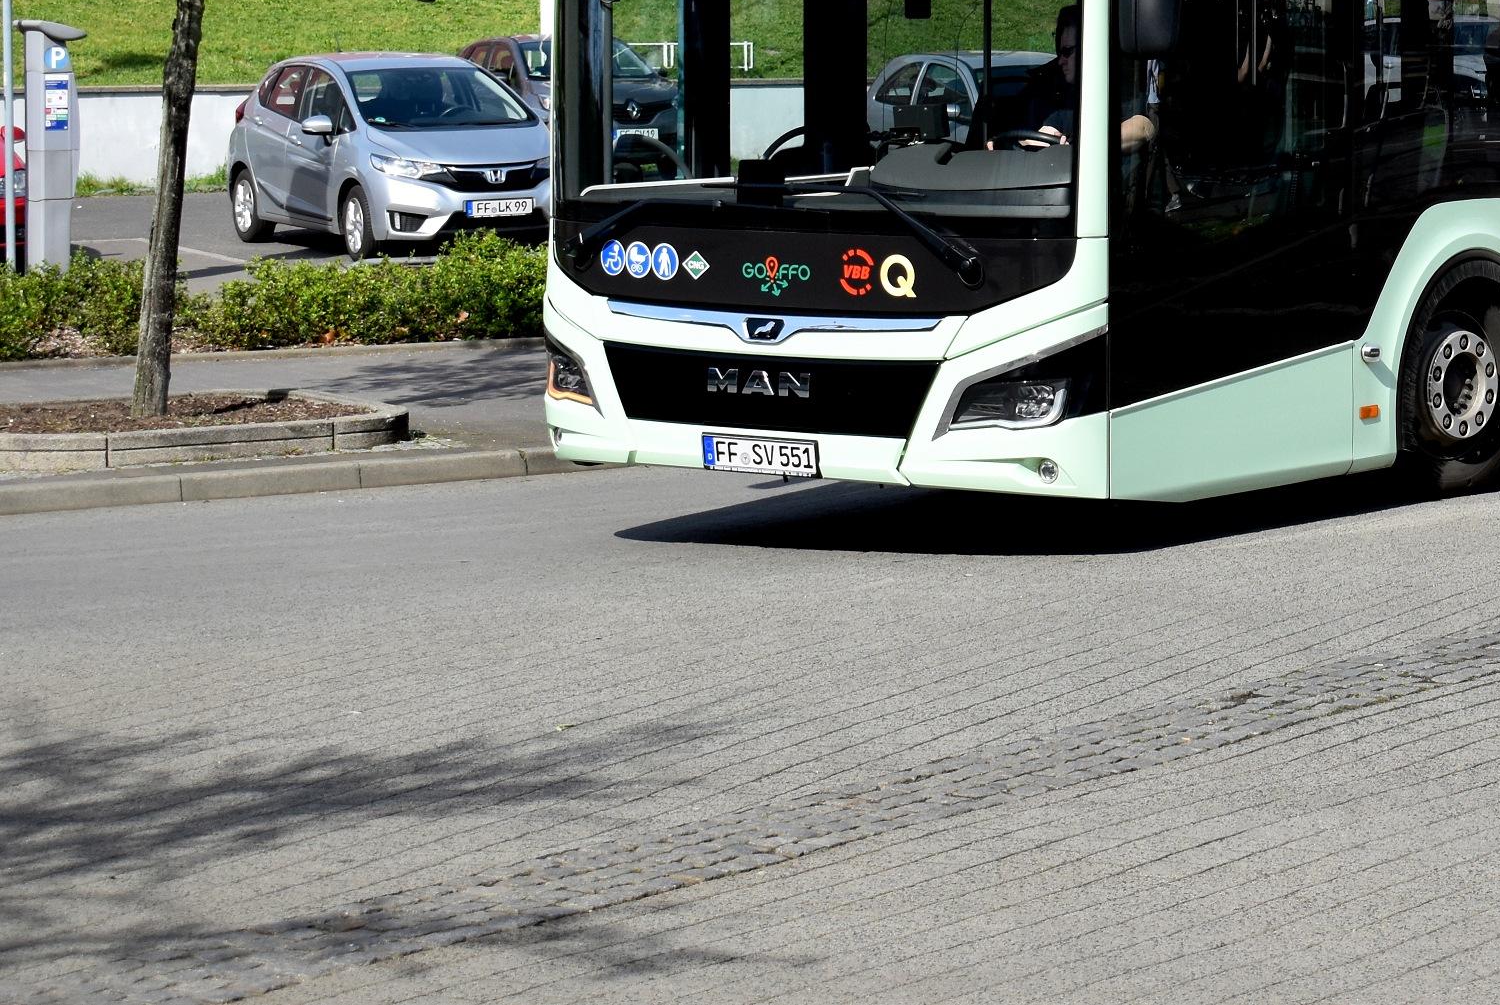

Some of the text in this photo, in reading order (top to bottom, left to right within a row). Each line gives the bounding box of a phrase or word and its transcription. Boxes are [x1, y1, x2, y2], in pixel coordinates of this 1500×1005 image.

[51, 47, 66, 69] P
[477, 200, 528, 213] FF LK 99
[687, 260, 705, 271] CNG
[844, 264, 870, 280] VBB
[880, 254, 917, 298] Q
[707, 367, 811, 398] MAN
[715, 440, 739, 463] FF
[752, 444, 775, 466] SV
[779, 445, 813, 470] 551
